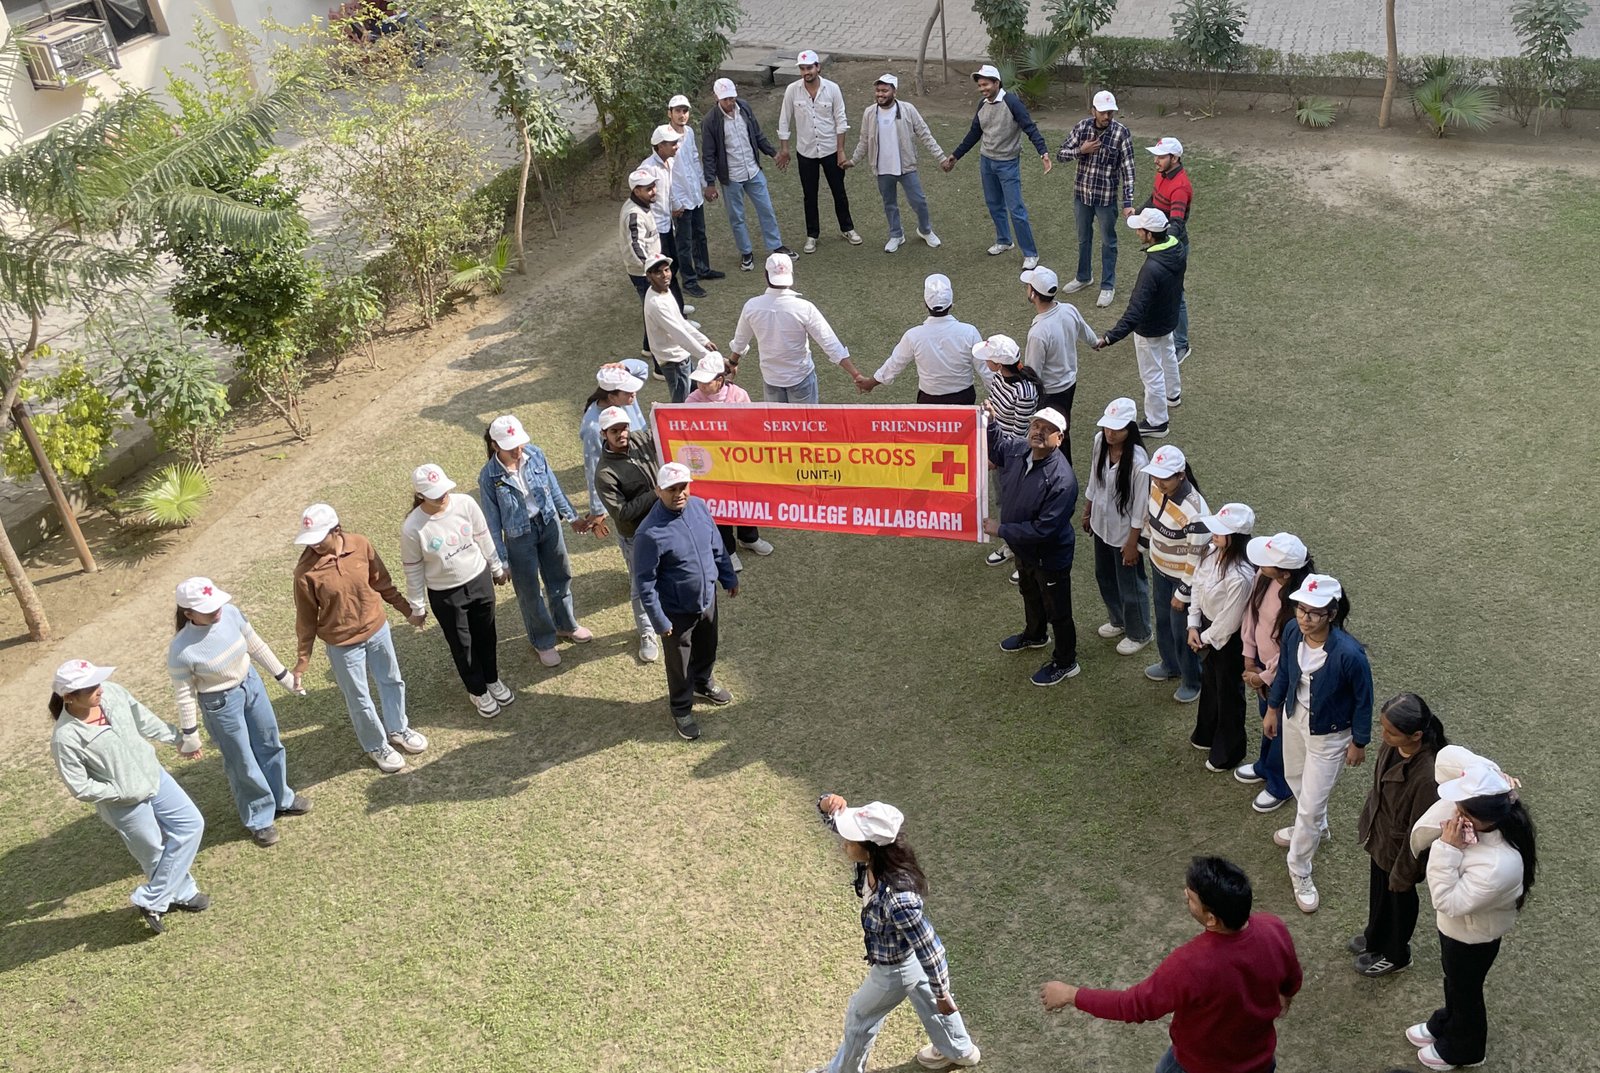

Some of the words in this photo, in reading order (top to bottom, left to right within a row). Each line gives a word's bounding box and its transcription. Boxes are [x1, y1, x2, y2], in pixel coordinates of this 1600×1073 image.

[669, 420, 728, 432] HEALTH
[763, 420, 828, 433] SERVICE
[871, 420, 962, 433] FRIENDSHIP
[719, 446, 792, 464] YOUTH
[799, 447, 841, 465] RED
[848, 448, 916, 467] CROSS
[796, 468, 842, 483] (UNIT-I)
[700, 498, 773, 520] GARWAL
[777, 503, 847, 525] COLLEGE
[852, 506, 962, 531] BALLABGARH
